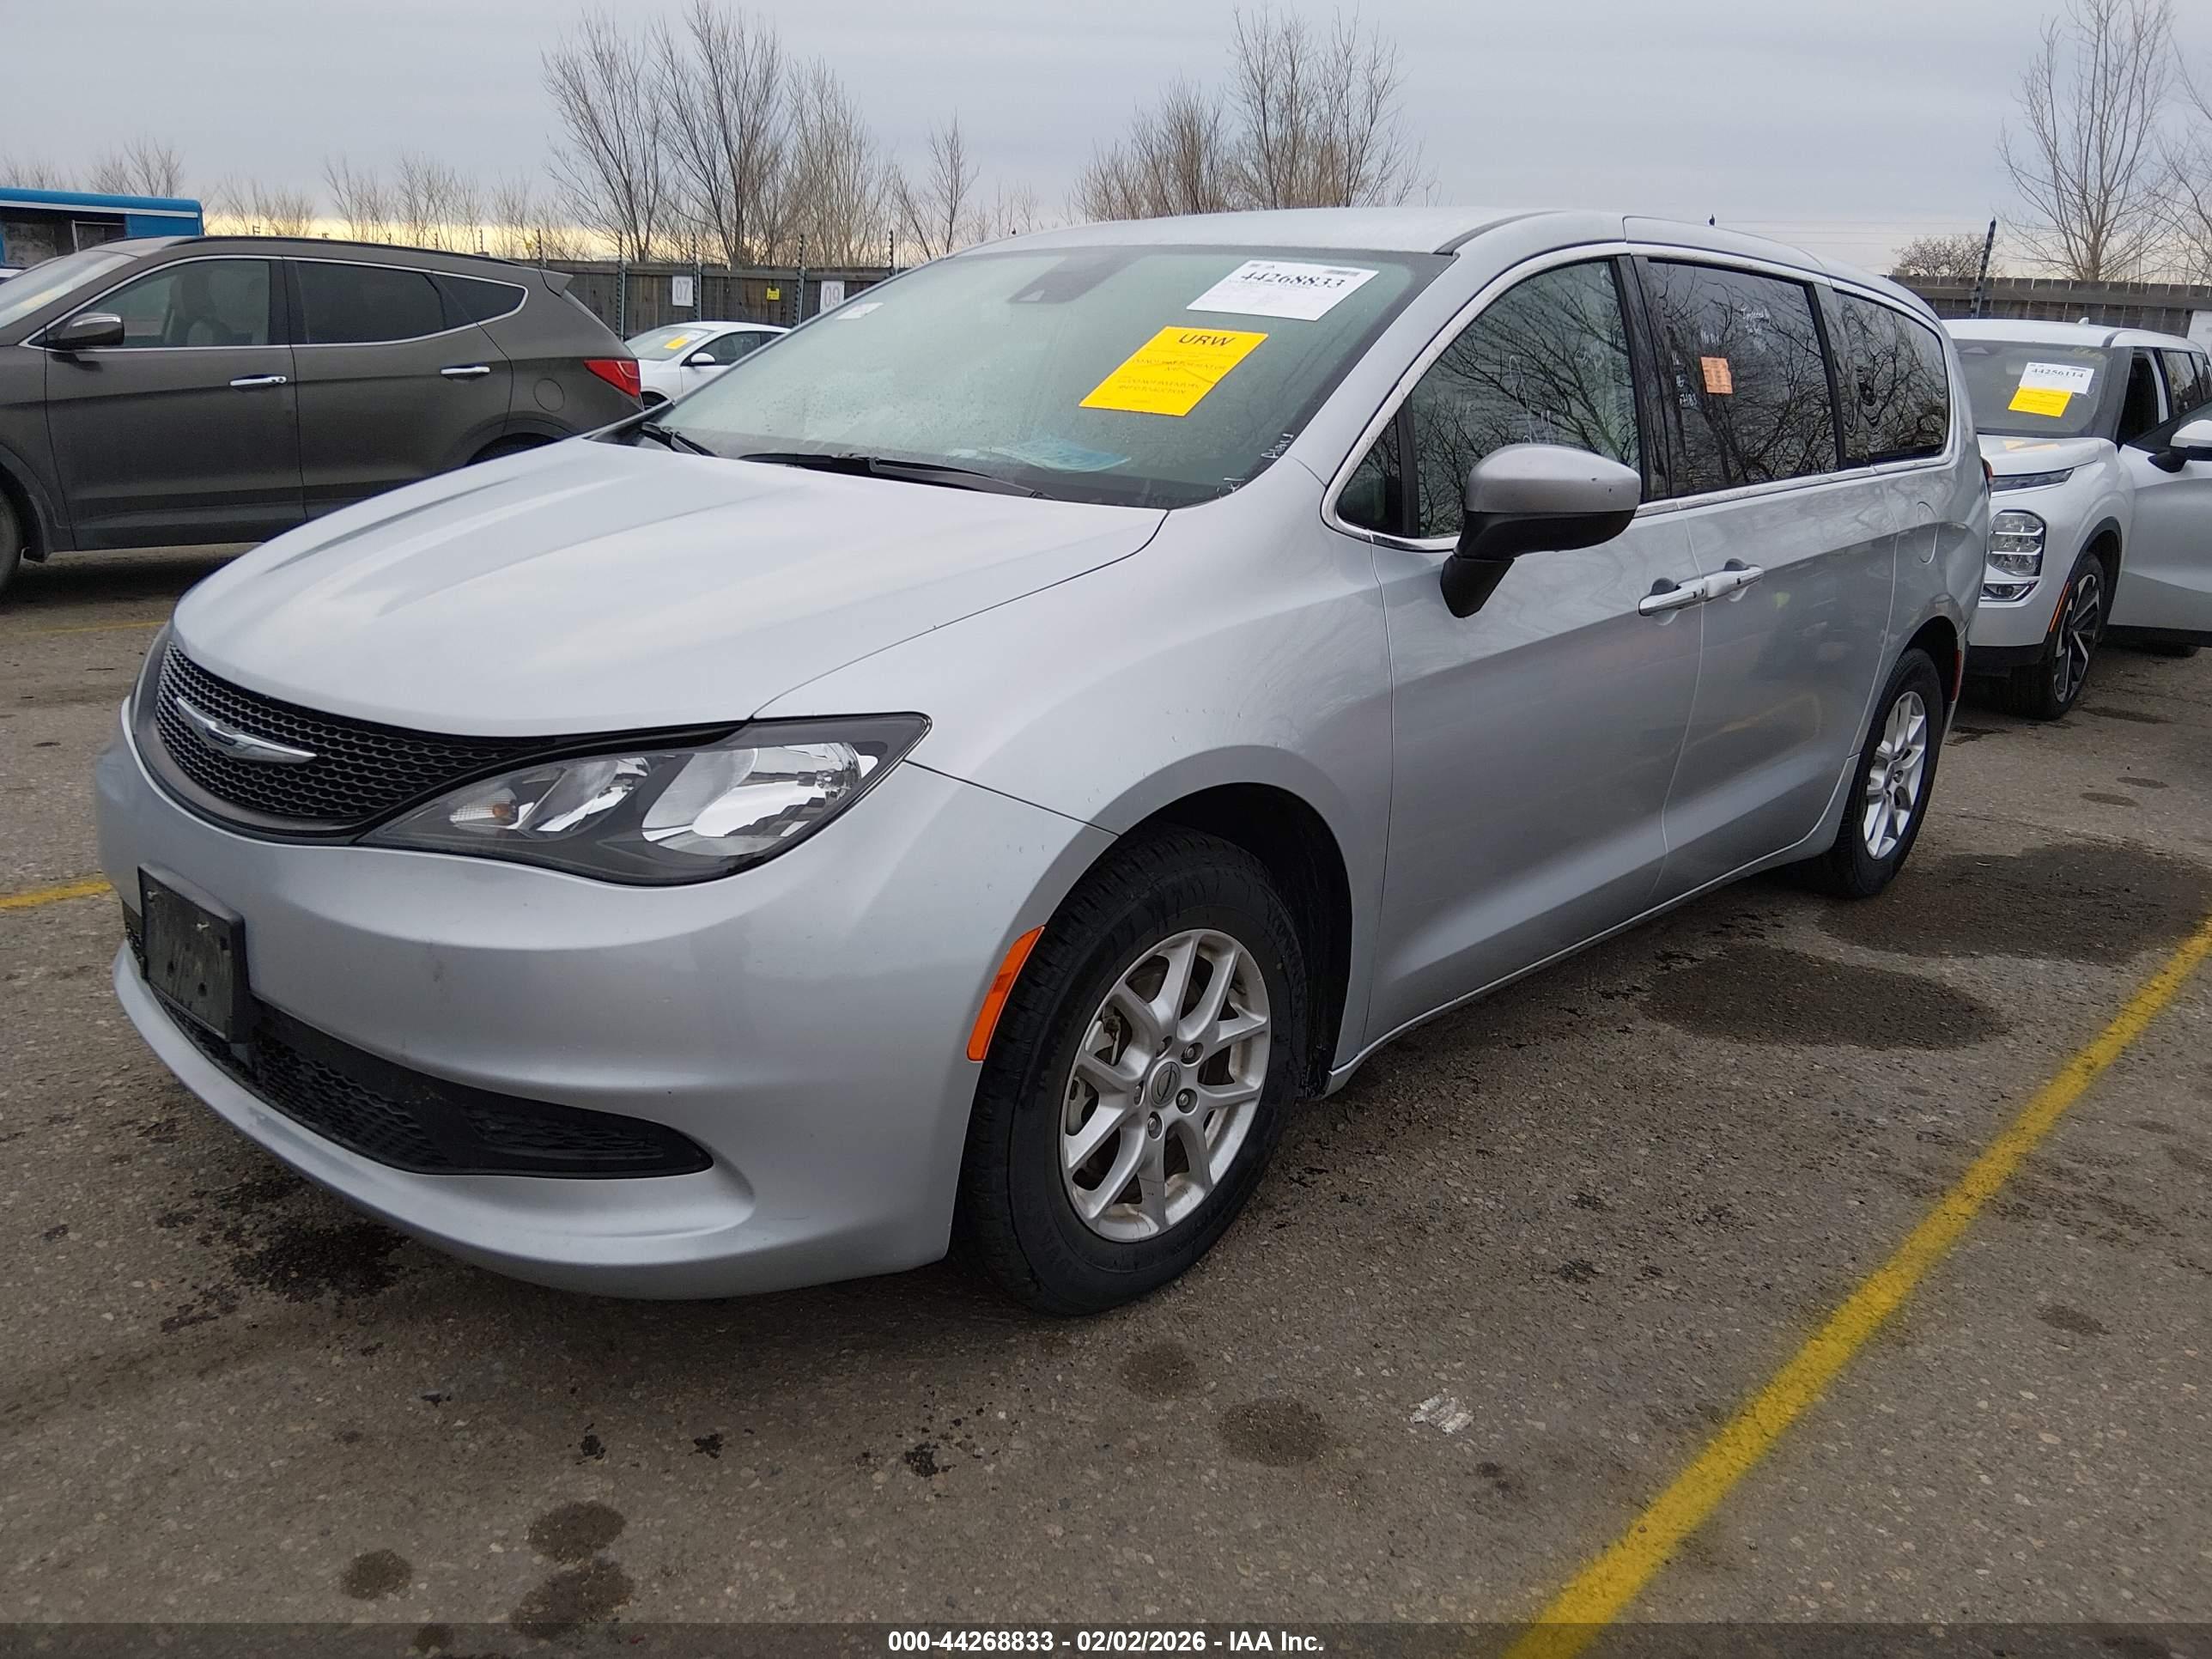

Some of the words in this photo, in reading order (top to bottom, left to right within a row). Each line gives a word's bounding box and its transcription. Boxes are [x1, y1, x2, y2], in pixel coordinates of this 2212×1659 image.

[1241, 271, 1346, 289] 44268833
[676, 280, 690, 300] 07
[824, 286, 841, 307] 09
[1179, 333, 1237, 346] URW
